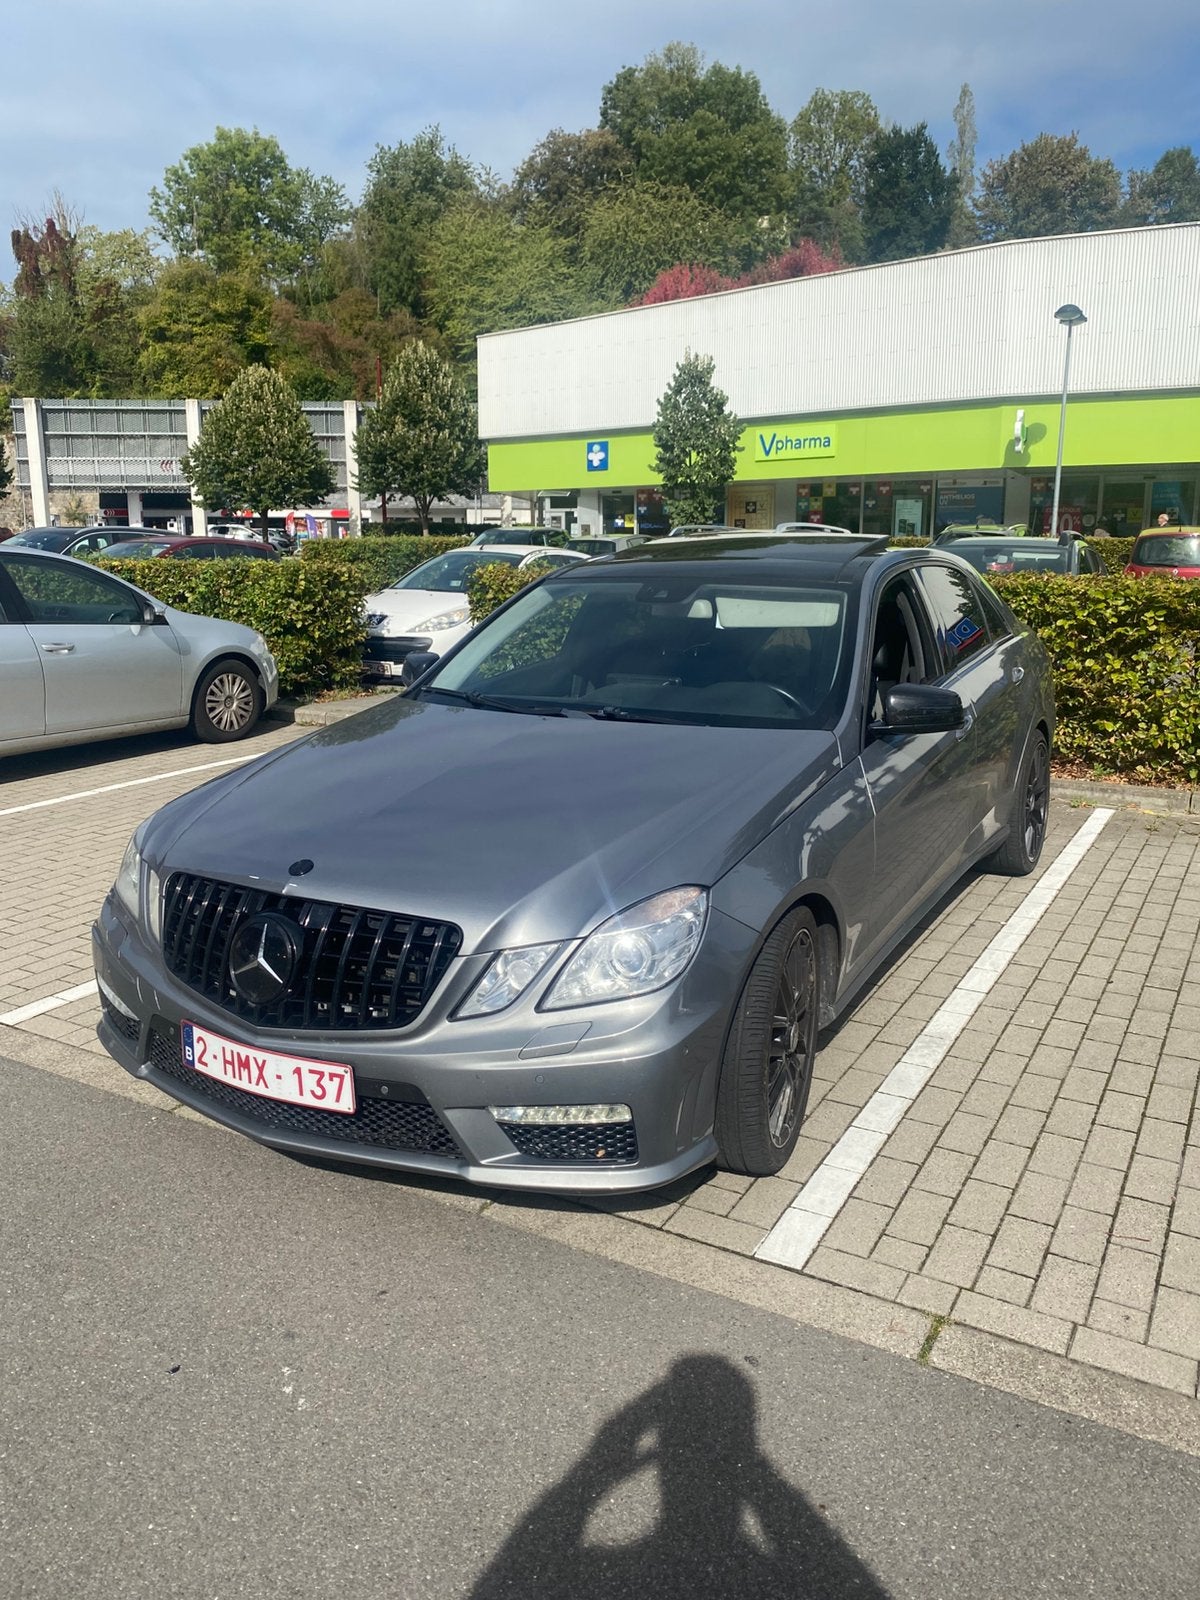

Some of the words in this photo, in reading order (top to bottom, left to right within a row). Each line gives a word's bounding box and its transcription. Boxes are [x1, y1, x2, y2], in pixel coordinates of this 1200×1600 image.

[759, 432, 831, 457] Vpharma
[185, 1046, 194, 1061] B
[196, 1035, 345, 1103] 2-HMX-137
